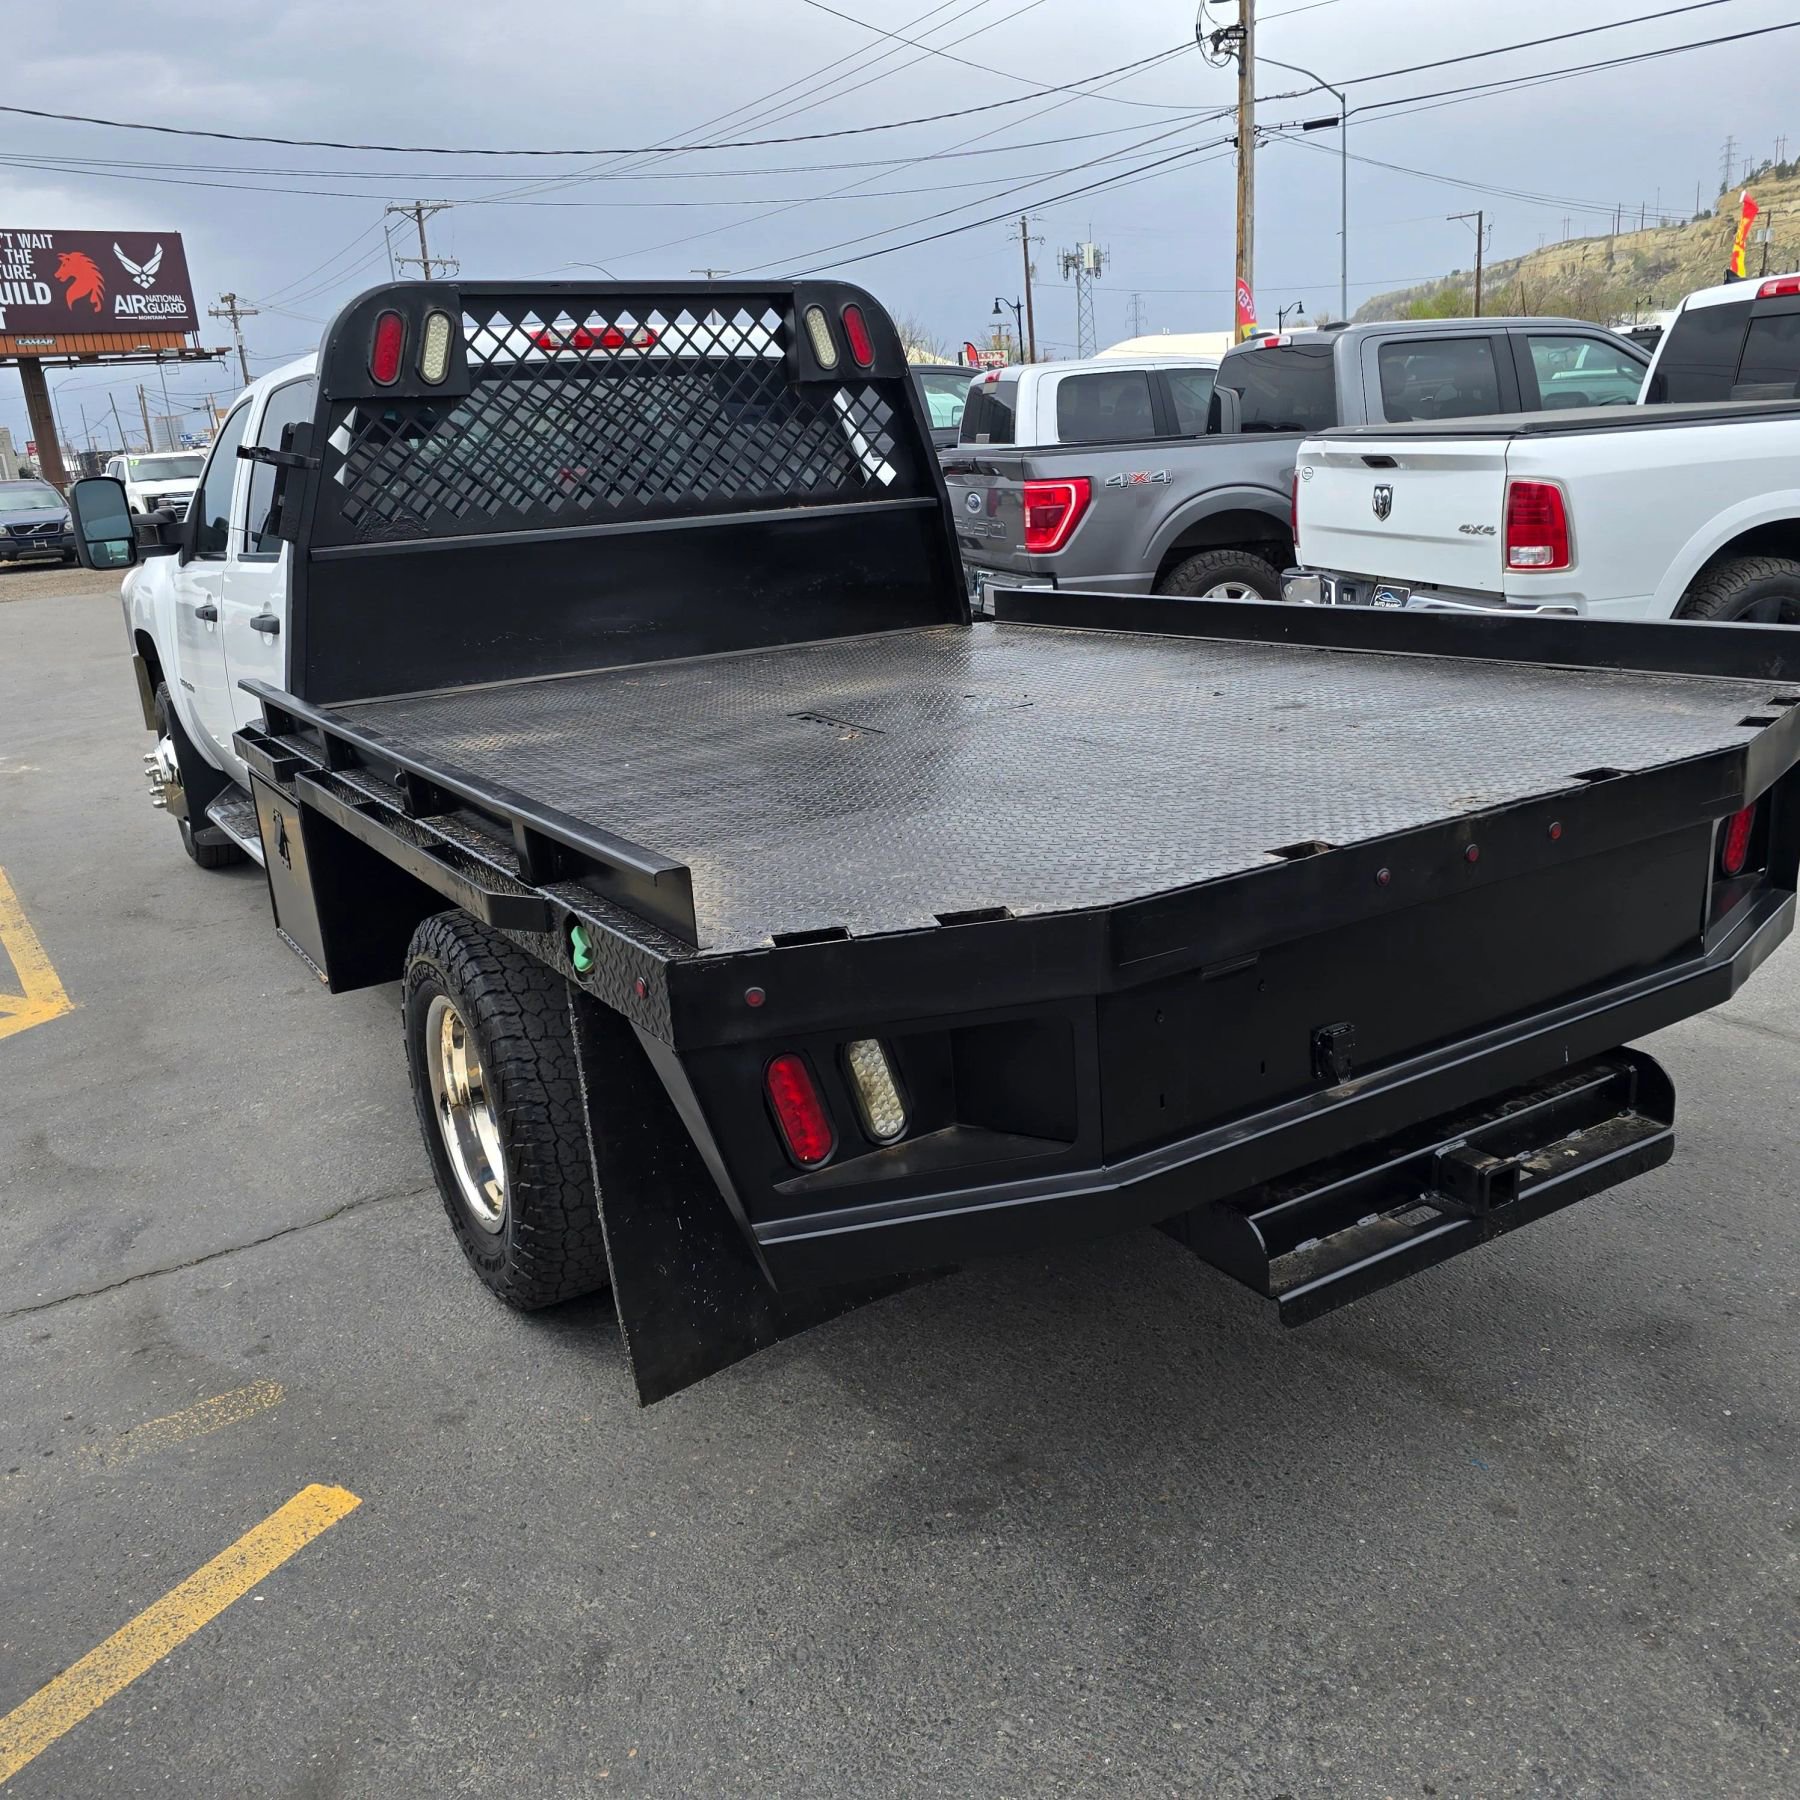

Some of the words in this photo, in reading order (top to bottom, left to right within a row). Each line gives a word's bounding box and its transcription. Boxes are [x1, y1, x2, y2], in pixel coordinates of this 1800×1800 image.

[17, 233, 53, 249] WAIT
[4, 249, 34, 264] THE
[114, 295, 148, 314] AIR
[145, 294, 184, 303] NATIONAL
[147, 302, 187, 314] GUARD
